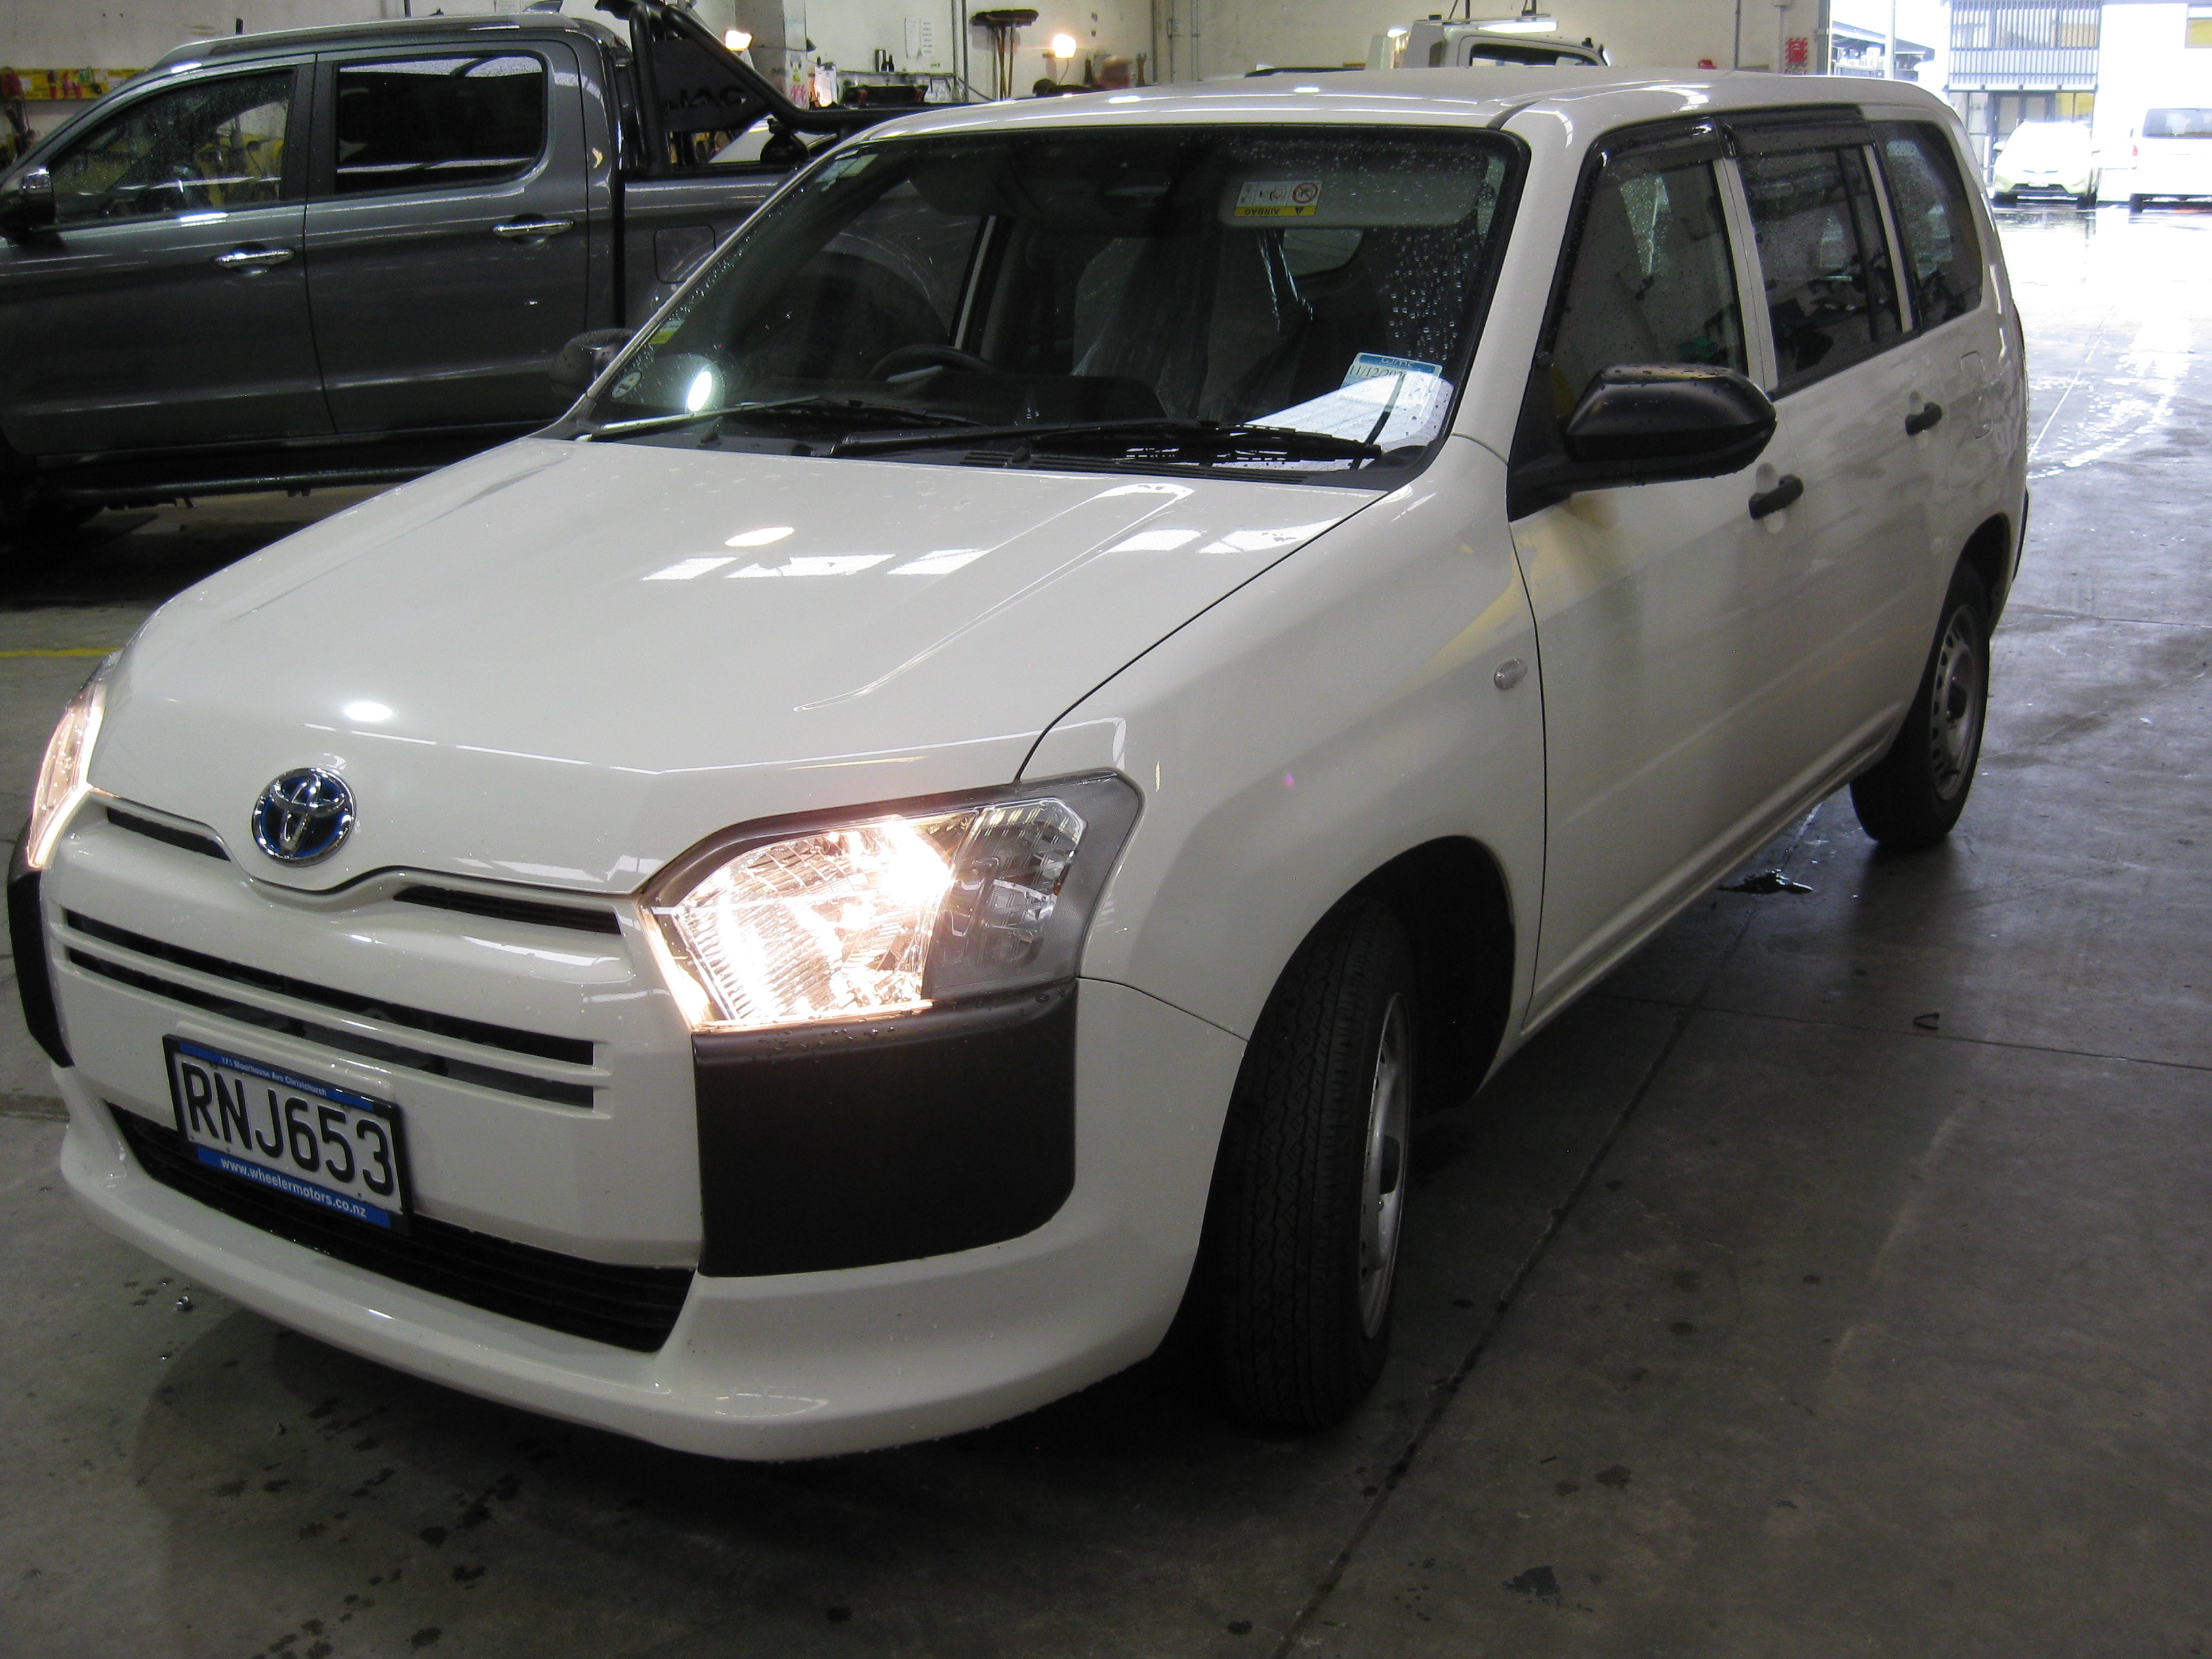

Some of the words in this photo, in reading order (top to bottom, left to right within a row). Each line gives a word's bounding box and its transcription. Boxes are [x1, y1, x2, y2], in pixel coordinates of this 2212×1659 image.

[234, 1060, 270, 1078] Moorhouse
[272, 1071, 284, 1082] Ave
[285, 1076, 327, 1096] Christchurch
[182, 1061, 394, 1197] RNJ653
[220, 1158, 367, 1218] www.wheelermotors.co.nz
